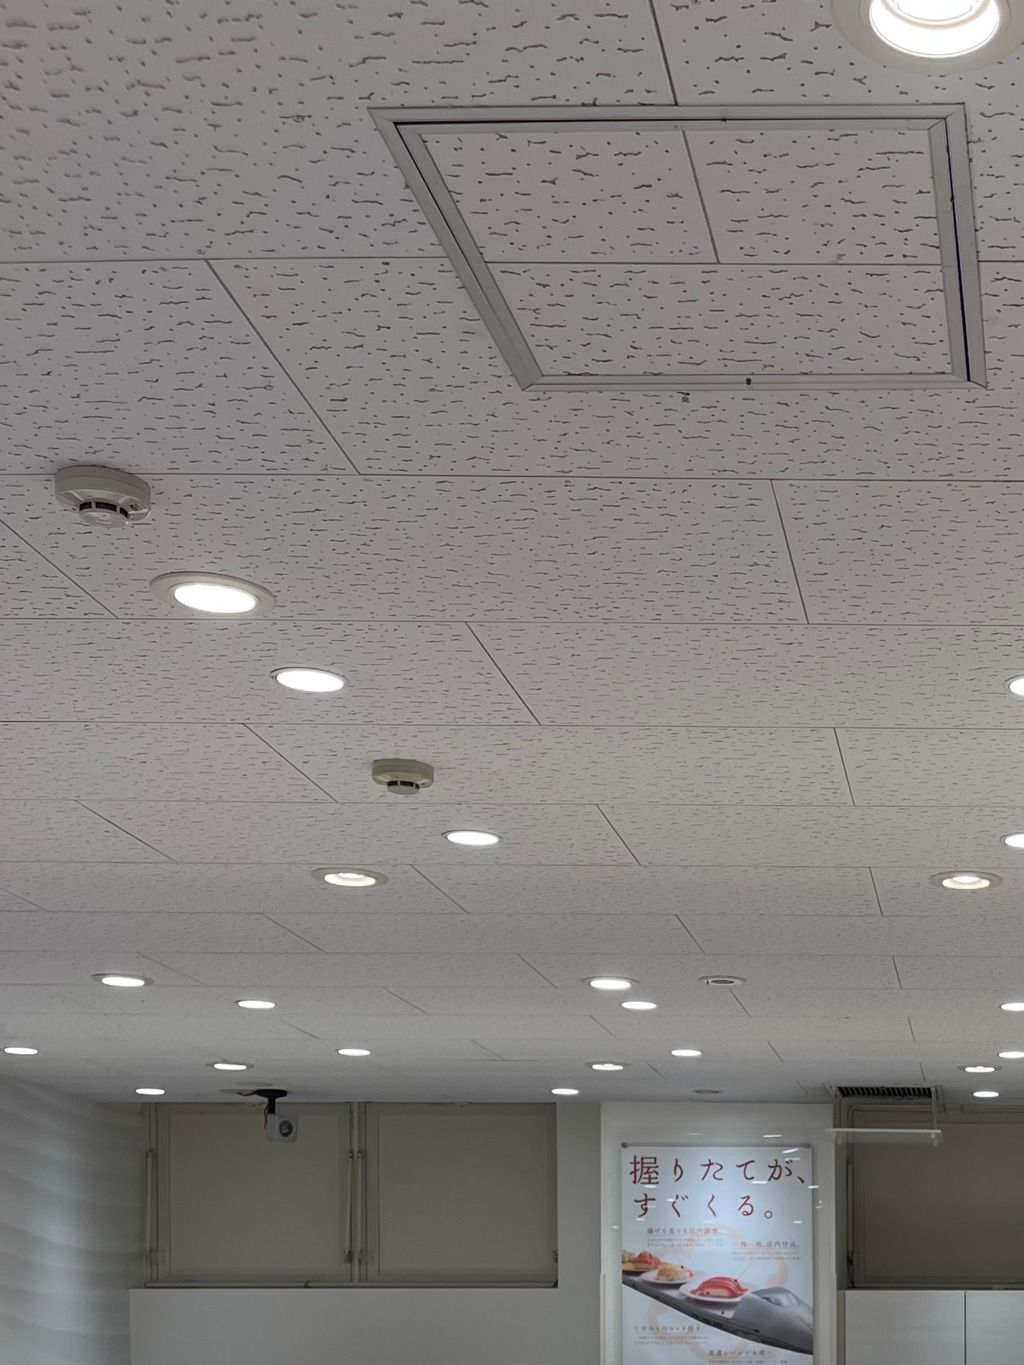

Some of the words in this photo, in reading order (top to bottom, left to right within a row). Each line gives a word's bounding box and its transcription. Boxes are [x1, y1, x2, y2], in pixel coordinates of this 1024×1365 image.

[629, 1155, 805, 1185] 握りたてが、
[633, 1193, 773, 1219] すぐくる。
